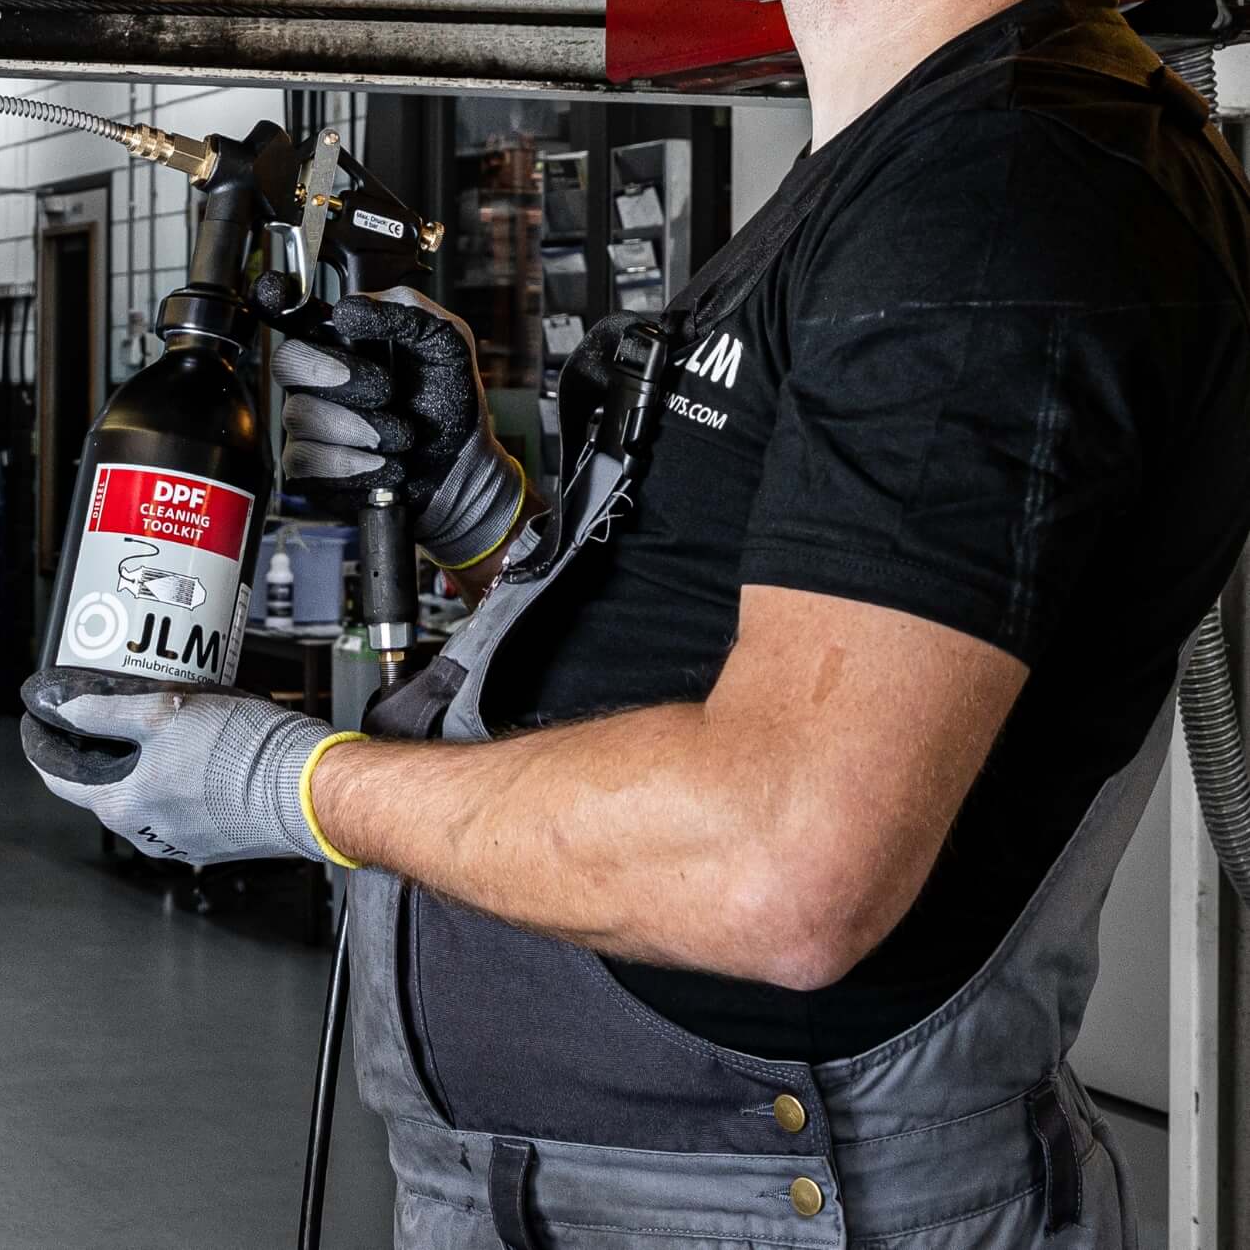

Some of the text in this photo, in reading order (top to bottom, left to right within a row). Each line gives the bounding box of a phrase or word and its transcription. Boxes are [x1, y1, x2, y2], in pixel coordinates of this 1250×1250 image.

[666, 393, 728, 430] NTS.COM
[93, 481, 105, 519] DIESEL
[153, 480, 206, 509] DPF
[140, 503, 210, 528] CLEANING
[142, 518, 204, 541] TOOLKIT
[127, 612, 220, 674] JLM
[121, 654, 215, 685] jlmlubricants.com
